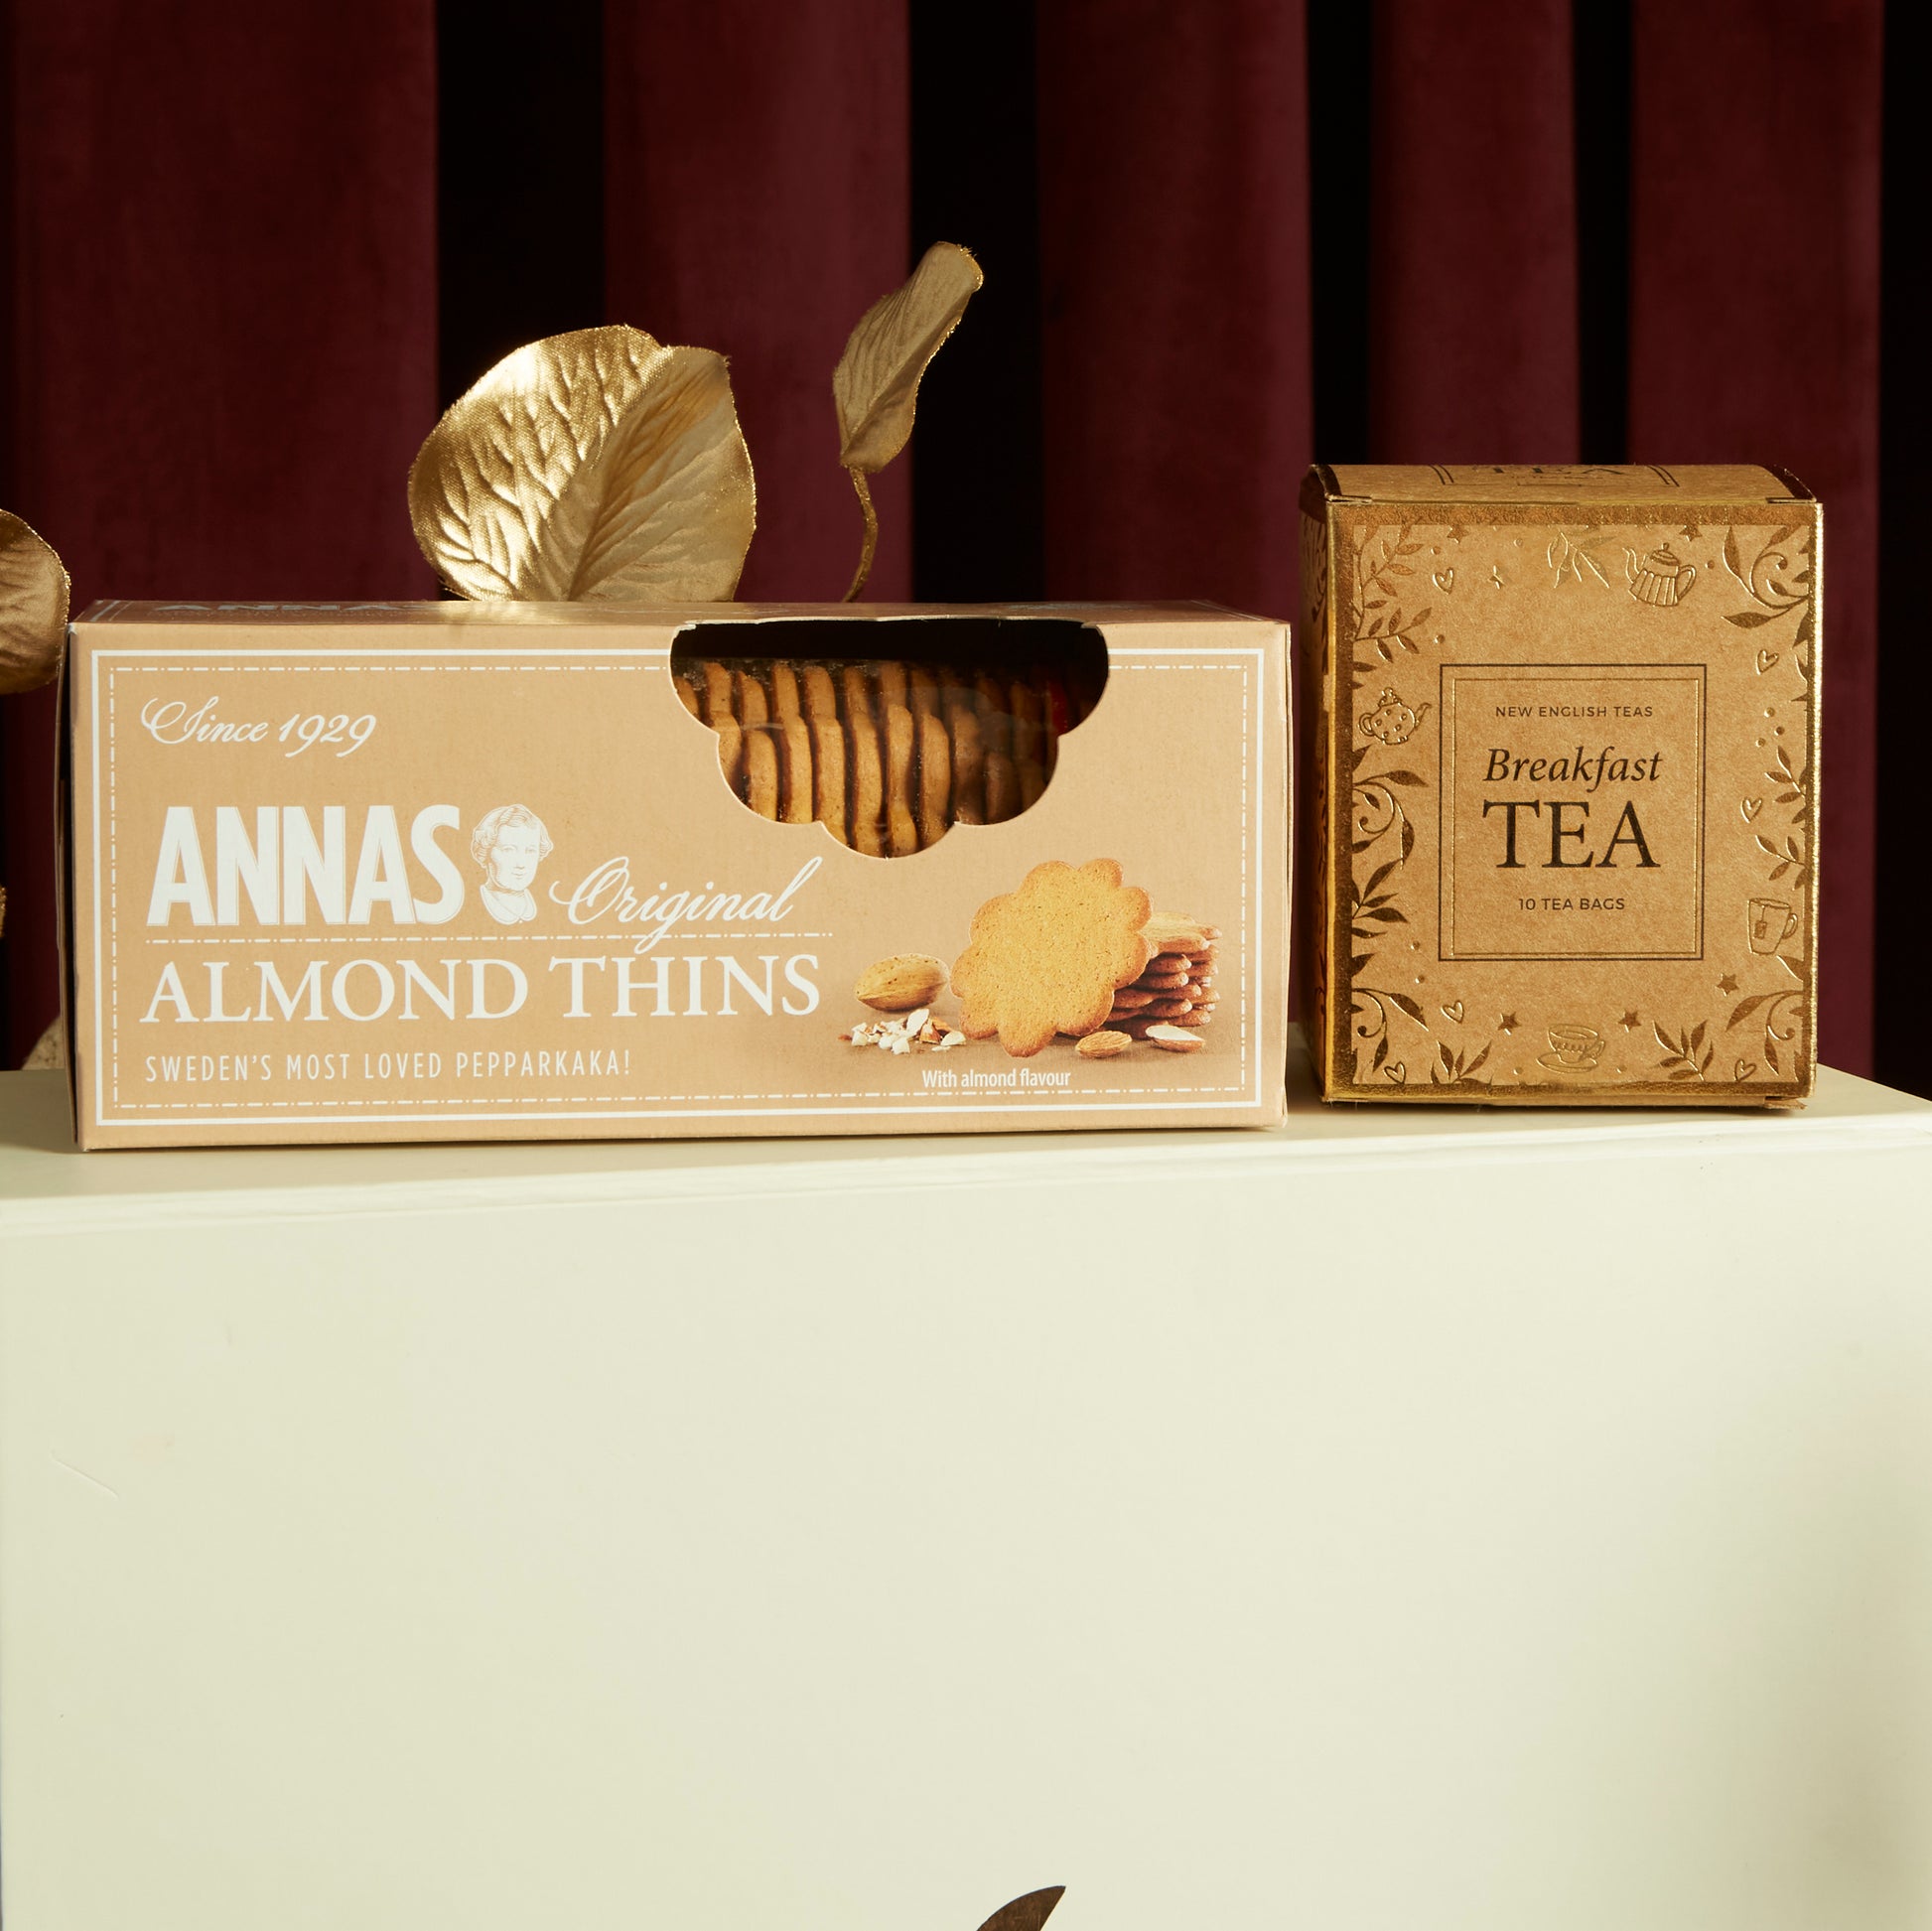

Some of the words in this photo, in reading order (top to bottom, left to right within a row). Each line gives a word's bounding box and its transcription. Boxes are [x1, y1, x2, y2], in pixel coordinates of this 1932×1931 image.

[140, 695, 269, 745] Since
[278, 713, 377, 759] 1929
[1495, 706, 1533, 718] NEW
[1538, 706, 1607, 718] ENGLISH
[1612, 706, 1653, 718] TEAS
[1482, 746, 1663, 793] Breakfast
[1482, 799, 1661, 869] TEA
[146, 803, 466, 927] ANNAS
[549, 855, 823, 954] Original
[1518, 897, 1537, 911] 10
[1540, 897, 1574, 911] TEA
[1579, 897, 1625, 911] BAGS
[139, 958, 529, 1024] ALMOND
[547, 953, 821, 1019] THINS
[286, 1053, 350, 1080] MOST
[364, 1051, 442, 1079] LOVED
[456, 1048, 629, 1078] PEPPARKAKA!
[921, 1069, 957, 1088] With
[960, 1068, 1018, 1088] almond
[1019, 1067, 1071, 1087] flavour
